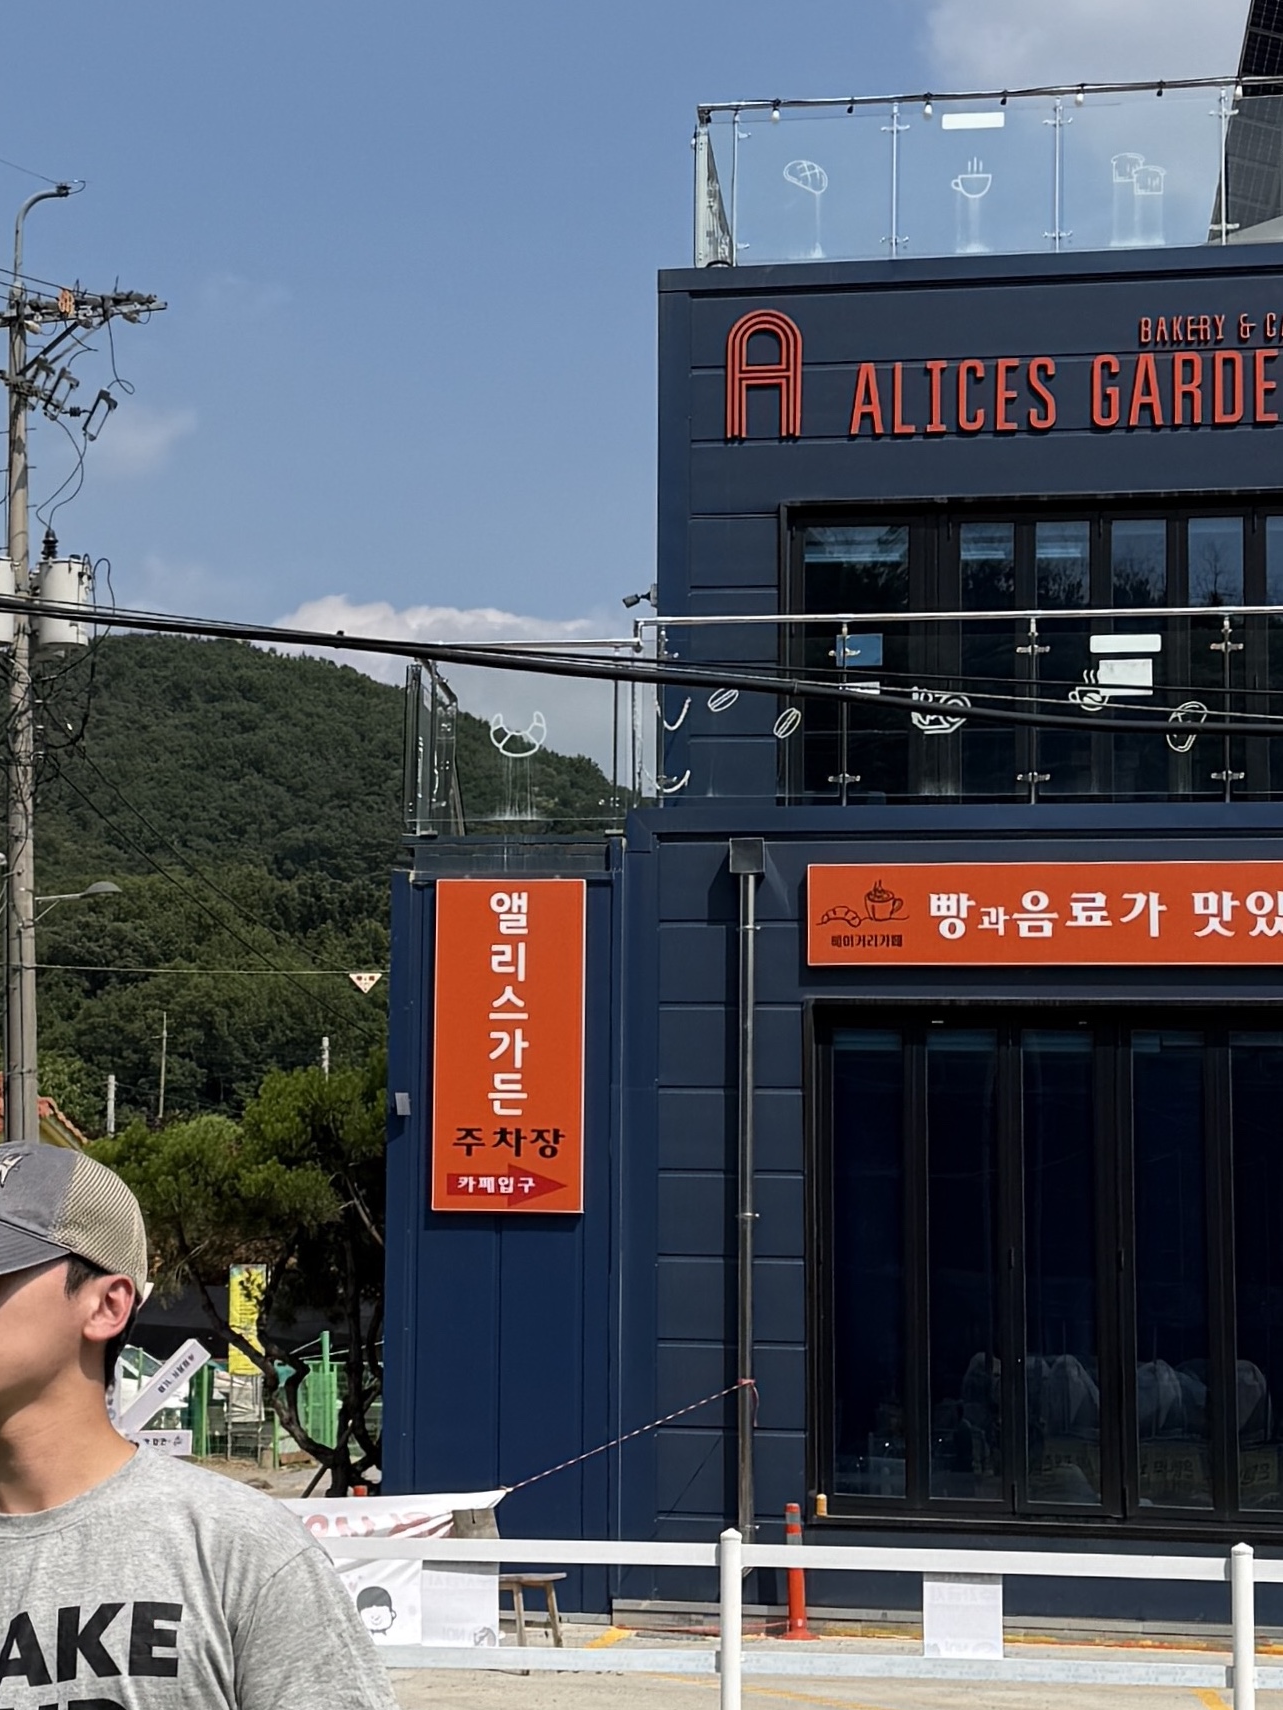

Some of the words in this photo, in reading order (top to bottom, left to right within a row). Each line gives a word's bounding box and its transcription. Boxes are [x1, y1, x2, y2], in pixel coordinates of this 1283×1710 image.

[1140, 314, 1226, 343] BAKERY
[1239, 313, 1257, 339] &
[1266, 312, 1283, 338] C
[849, 356, 1058, 436] ALICES
[1092, 349, 1280, 428] GARDE
[928, 890, 1168, 940] 빵과음료가
[487, 891, 530, 1117] 앨리스가든
[452, 1126, 567, 1160] 주차장
[457, 1175, 536, 1195] 카페입구
